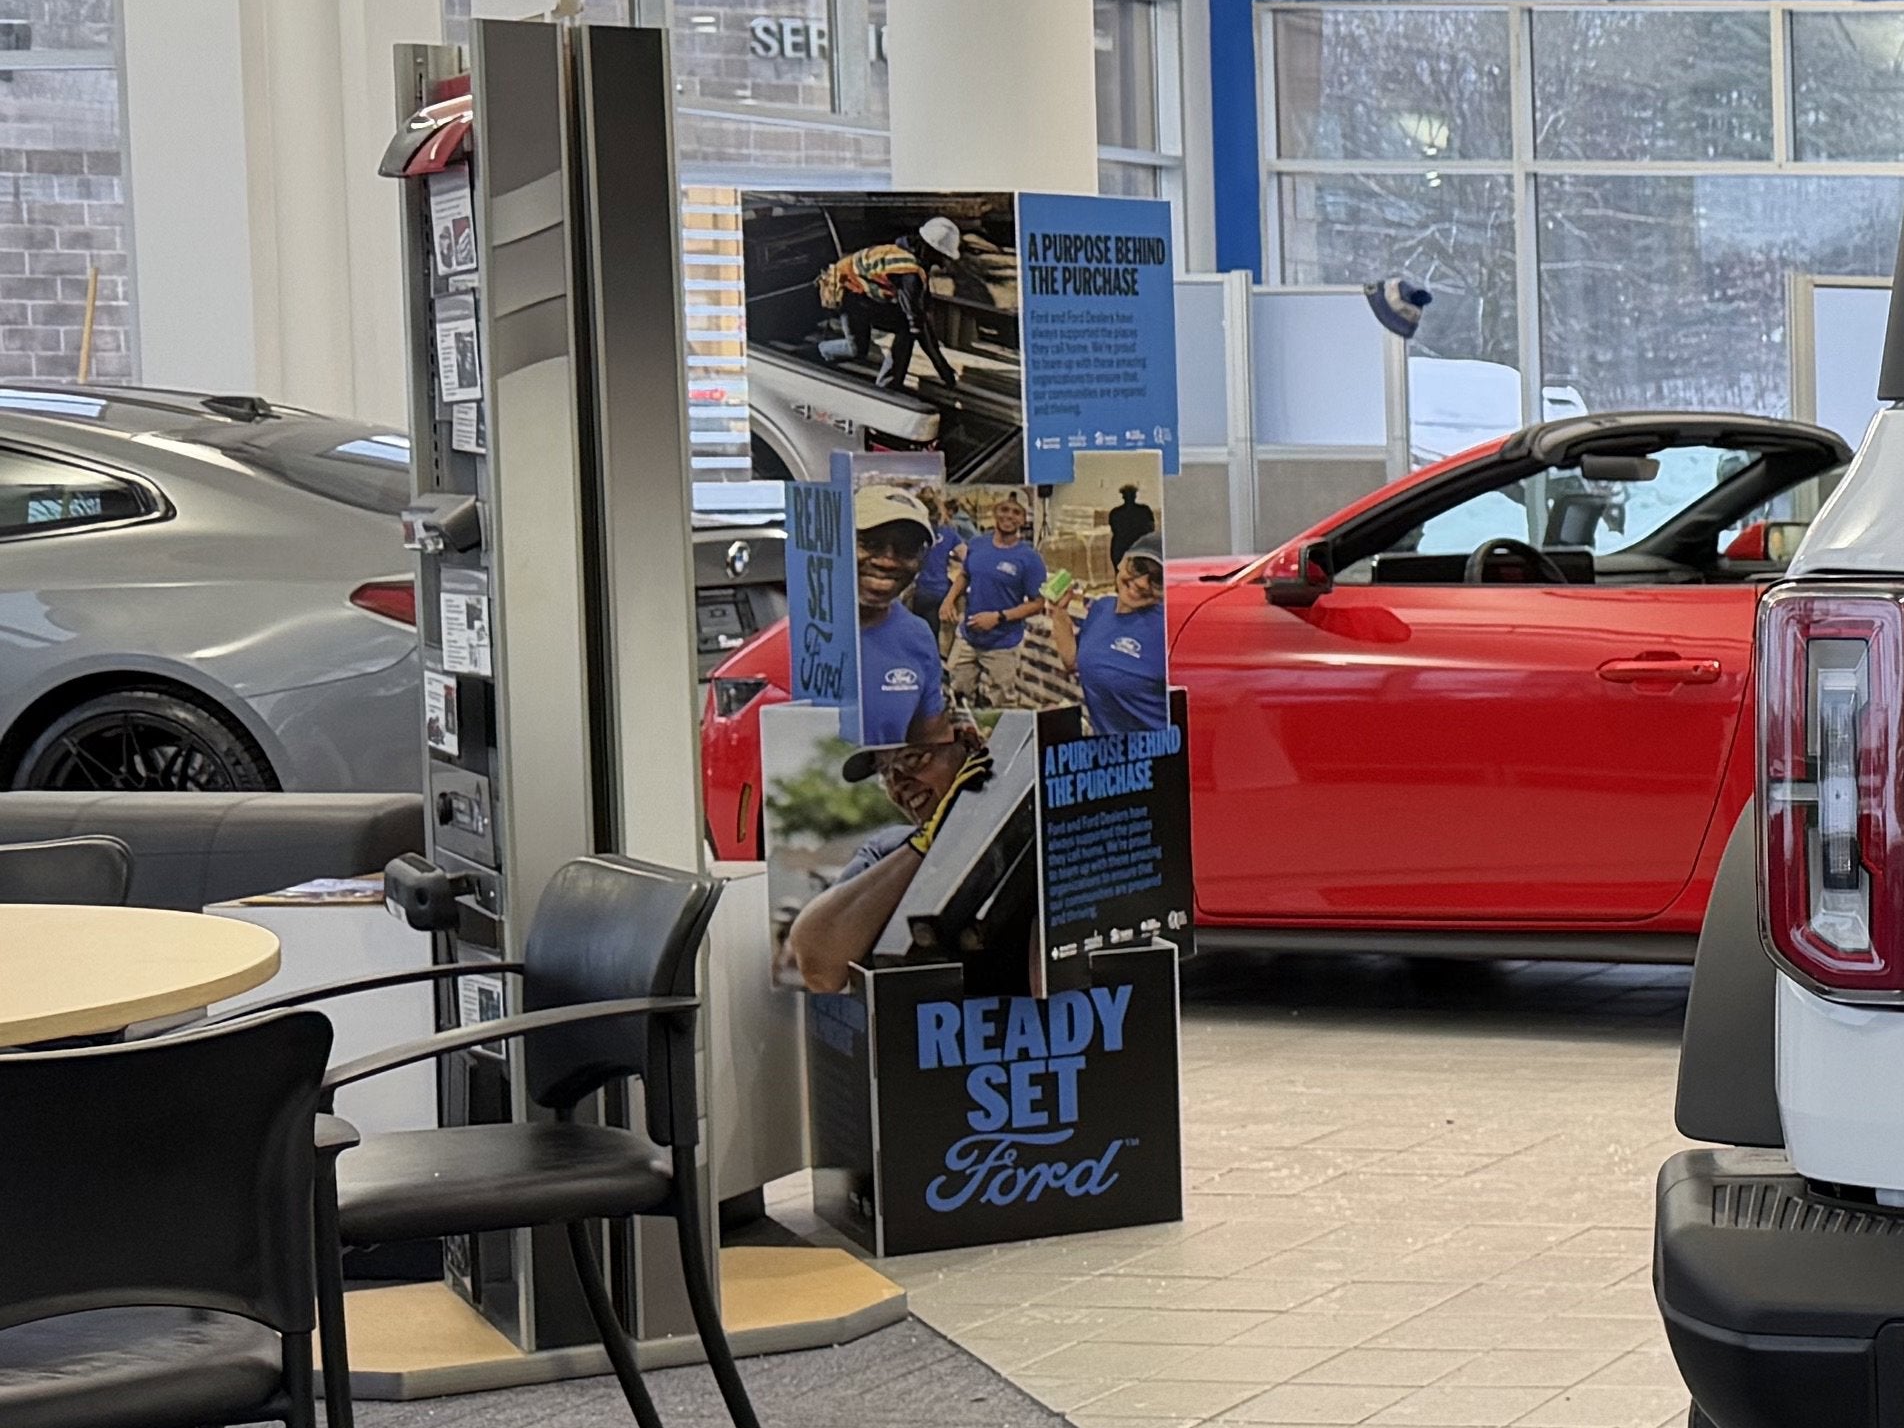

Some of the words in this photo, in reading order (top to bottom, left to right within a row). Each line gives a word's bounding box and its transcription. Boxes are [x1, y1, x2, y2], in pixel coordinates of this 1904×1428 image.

[1028, 233, 1039, 262] A
[1041, 233, 1112, 264] PURPOSE
[1115, 235, 1166, 266] BEHIND
[1029, 265, 1059, 296] THE
[1062, 266, 1139, 297] PURCHASE
[793, 486, 842, 557] READY
[807, 553, 834, 624] SET
[800, 623, 846, 701] Ford
[1045, 746, 1056, 776] A
[1058, 735, 1126, 774] PURPOSE
[1128, 724, 1182, 762] BEHIND
[1046, 774, 1075, 809] THE
[1077, 760, 1153, 803] PURCHASE
[916, 984, 1134, 1070] READY
[966, 1055, 1086, 1132] SET
[926, 1128, 1124, 1213] Ford
